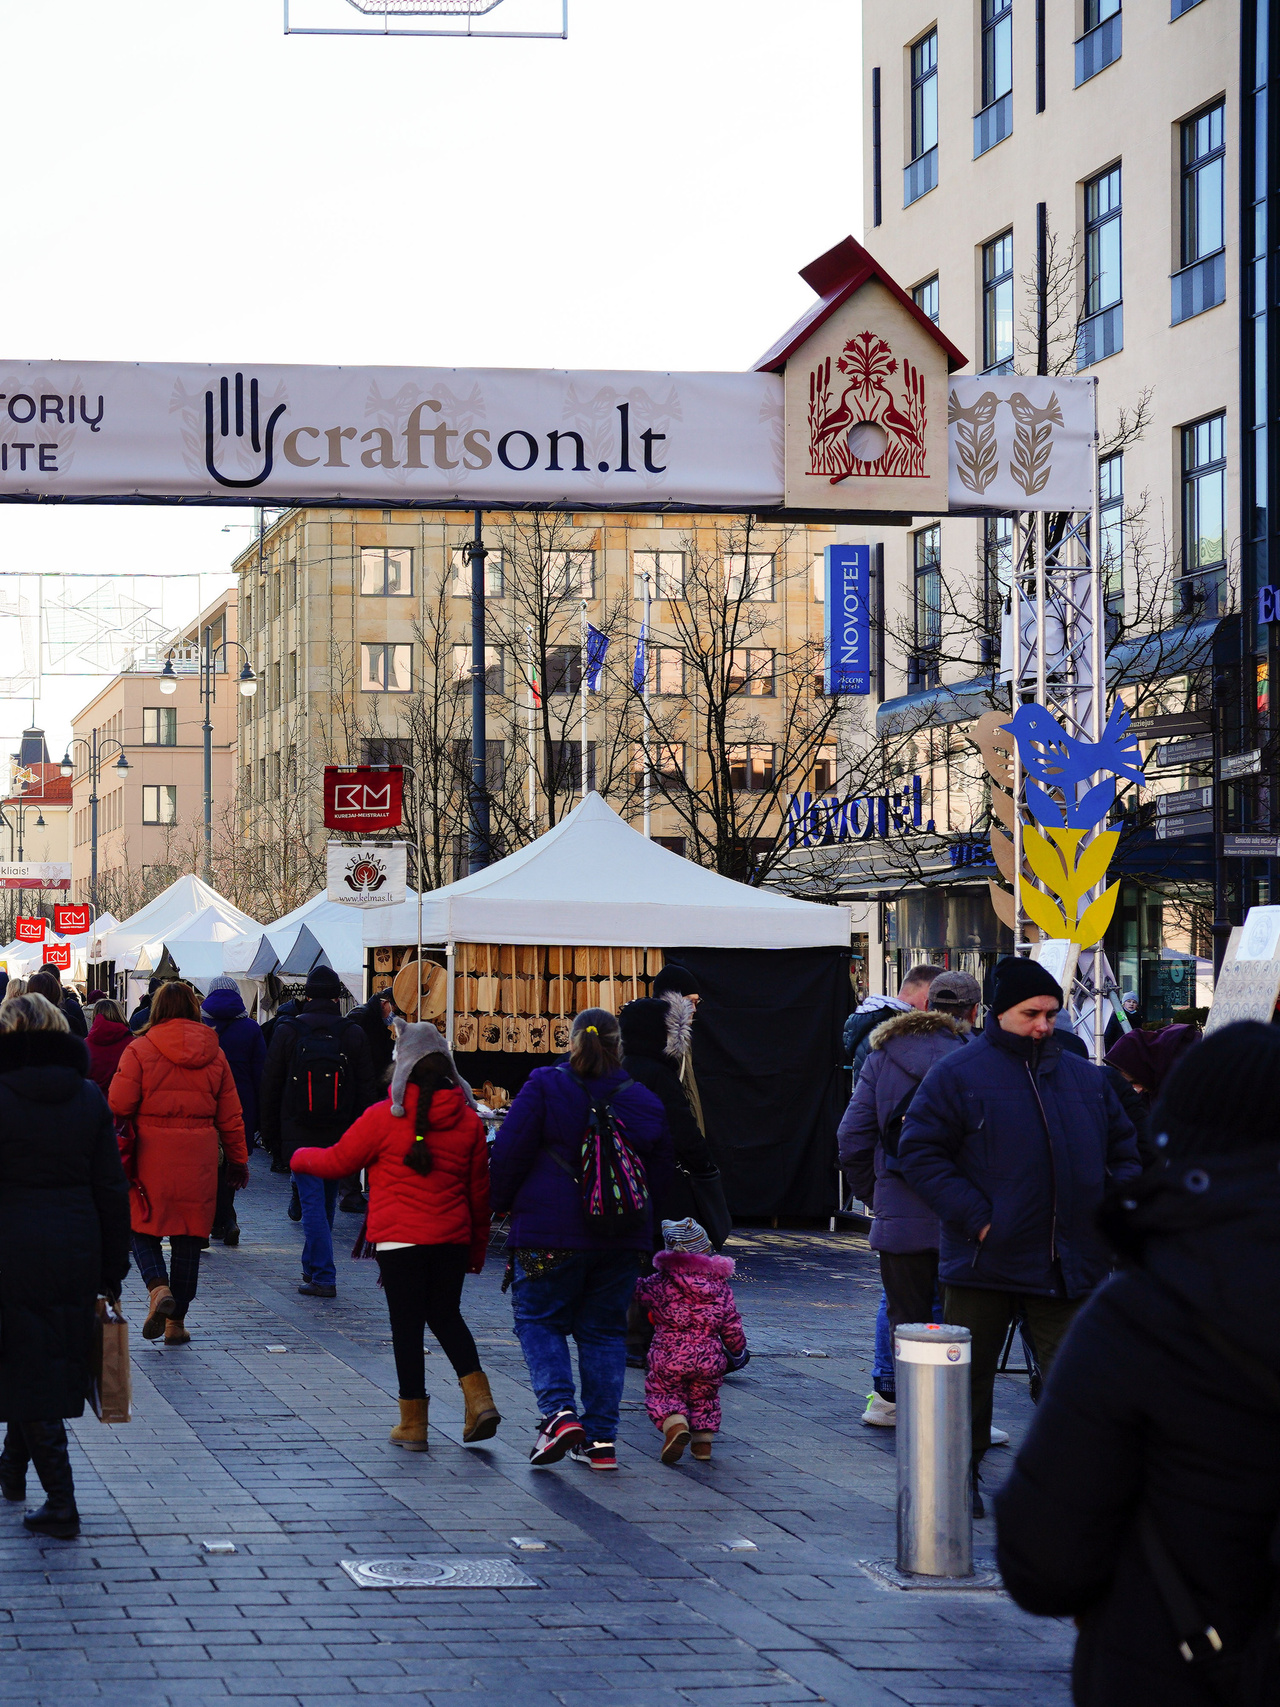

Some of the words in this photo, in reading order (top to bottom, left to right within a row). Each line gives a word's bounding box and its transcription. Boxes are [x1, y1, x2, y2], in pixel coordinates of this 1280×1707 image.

[283, 400, 667, 474] craftson.lt
[840, 551, 859, 664] NOVOTEL
[345, 852, 387, 871] KELMAS
[339, 892, 393, 902] www.kelmas.lt
